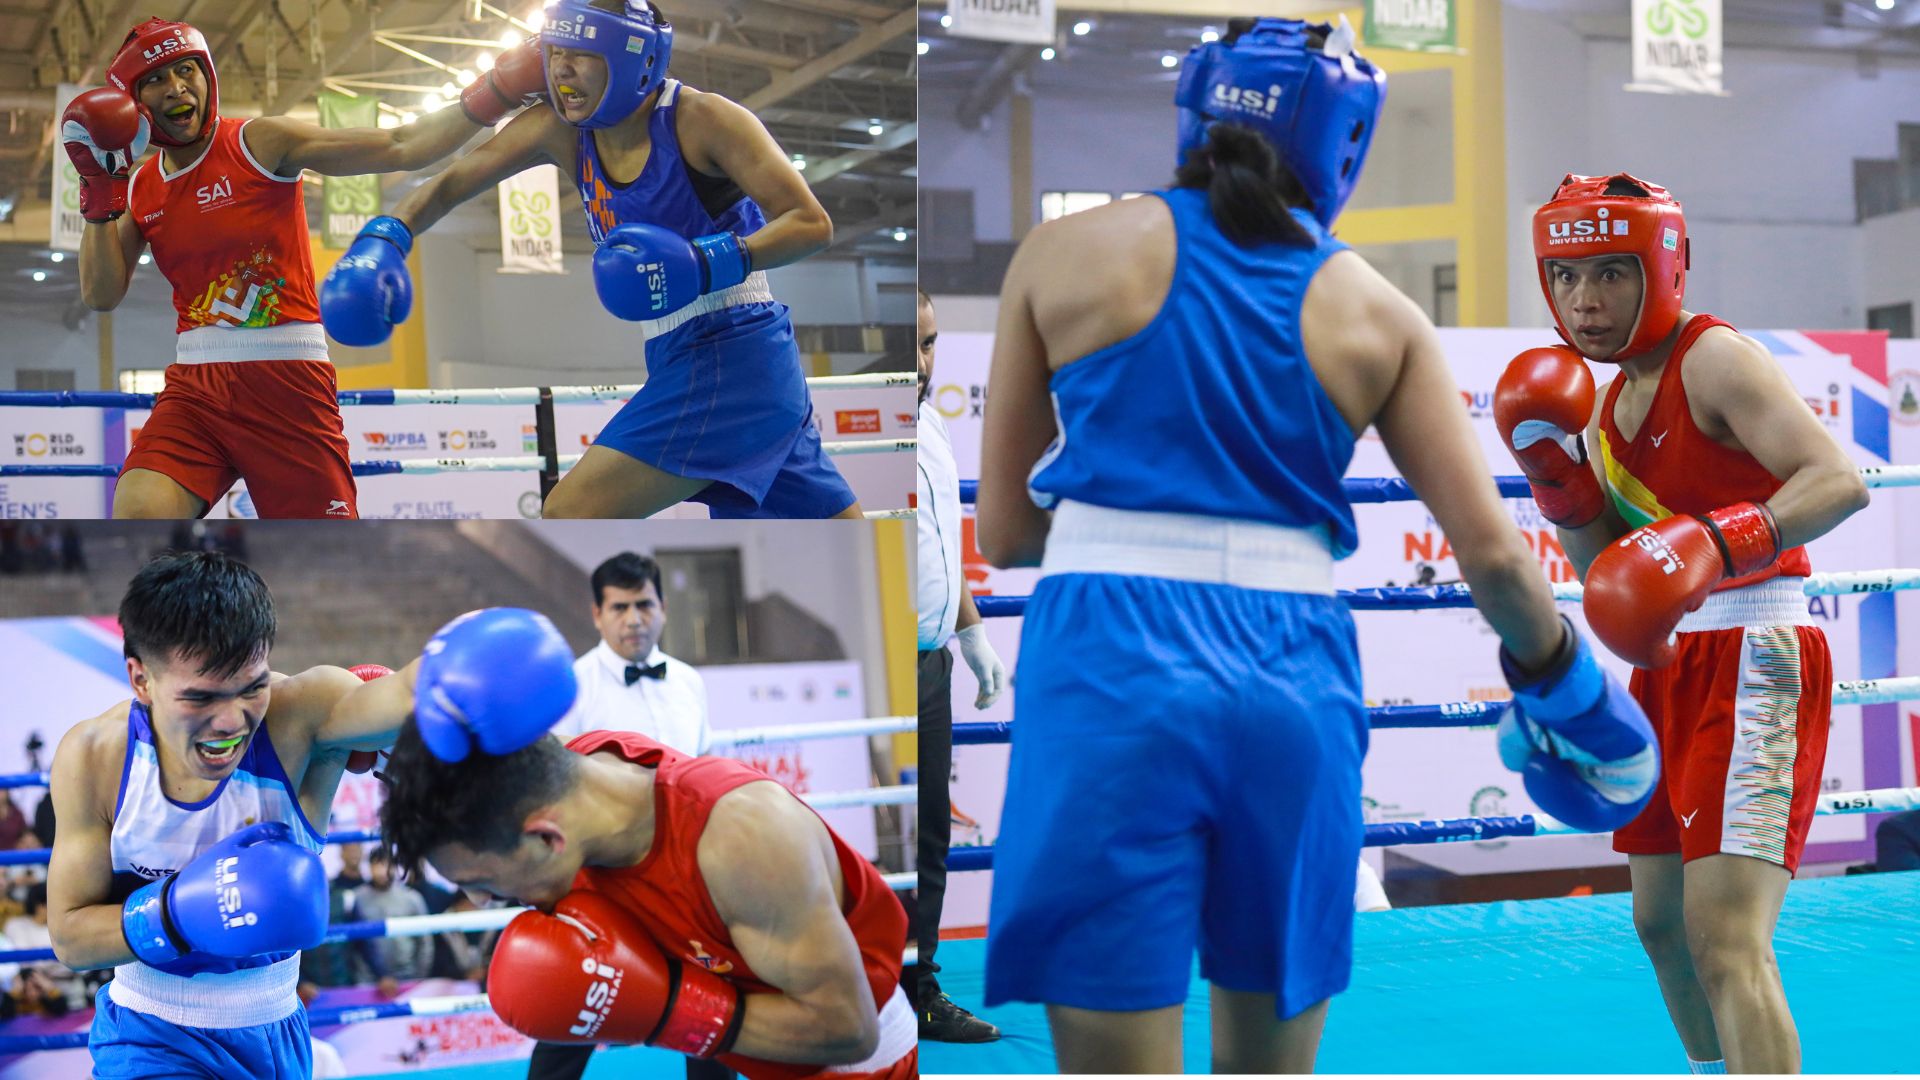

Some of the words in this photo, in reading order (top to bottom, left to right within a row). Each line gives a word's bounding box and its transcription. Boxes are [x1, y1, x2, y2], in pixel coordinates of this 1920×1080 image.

[543, 14, 585, 35] usi
[143, 29, 187, 59] usi
[1215, 83, 1282, 113] usi
[197, 175, 233, 204] SAI
[1549, 207, 1610, 238] usi
[1549, 236, 1611, 245] UNIVERSAL
[636, 262, 663, 311] usi
[1619, 530, 1677, 575] usi
[1851, 576, 1893, 593] usi
[1440, 701, 1487, 716] usi
[1833, 793, 1873, 810] usi
[222, 856, 258, 928] usi
[569, 957, 616, 1036] usi
